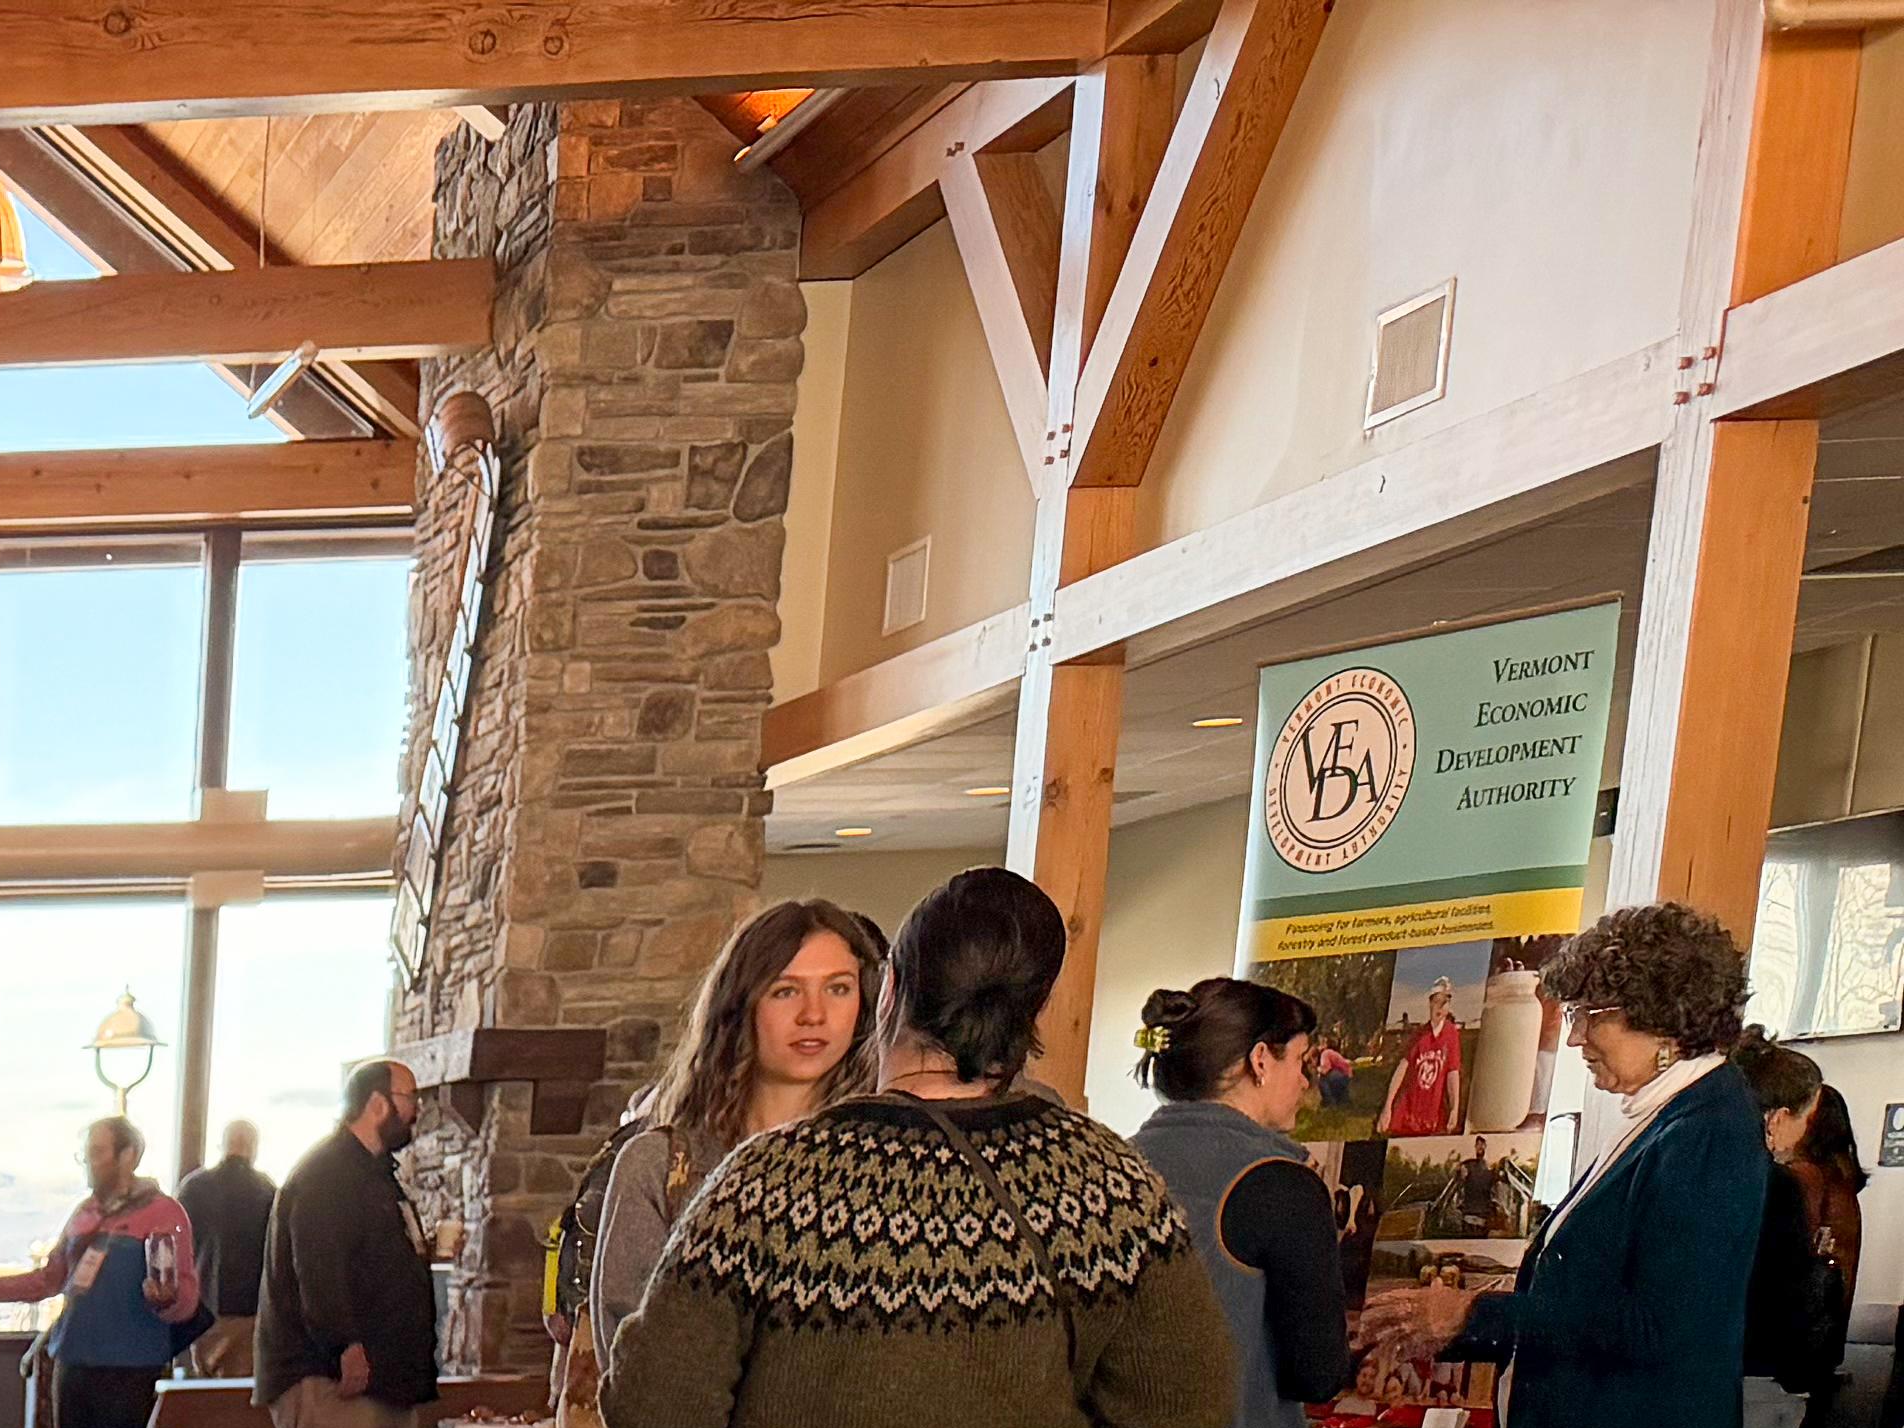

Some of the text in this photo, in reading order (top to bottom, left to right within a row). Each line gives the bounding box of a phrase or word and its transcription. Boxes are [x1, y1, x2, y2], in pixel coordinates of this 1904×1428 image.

[1493, 650, 1595, 684] VERMONT
[1474, 693, 1589, 728] ECONOMIC
[1434, 735, 1583, 774] DEVELOPMENT
[1456, 777, 1577, 811] AUTHORITY
[1278, 936, 1315, 951] forestry
[1317, 934, 1337, 948] and
[1337, 931, 1368, 946] forest
[1369, 925, 1440, 945] product-based
[1286, 920, 1336, 935] Financing
[1335, 918, 1350, 931] for
[1394, 907, 1450, 925] agricultural
